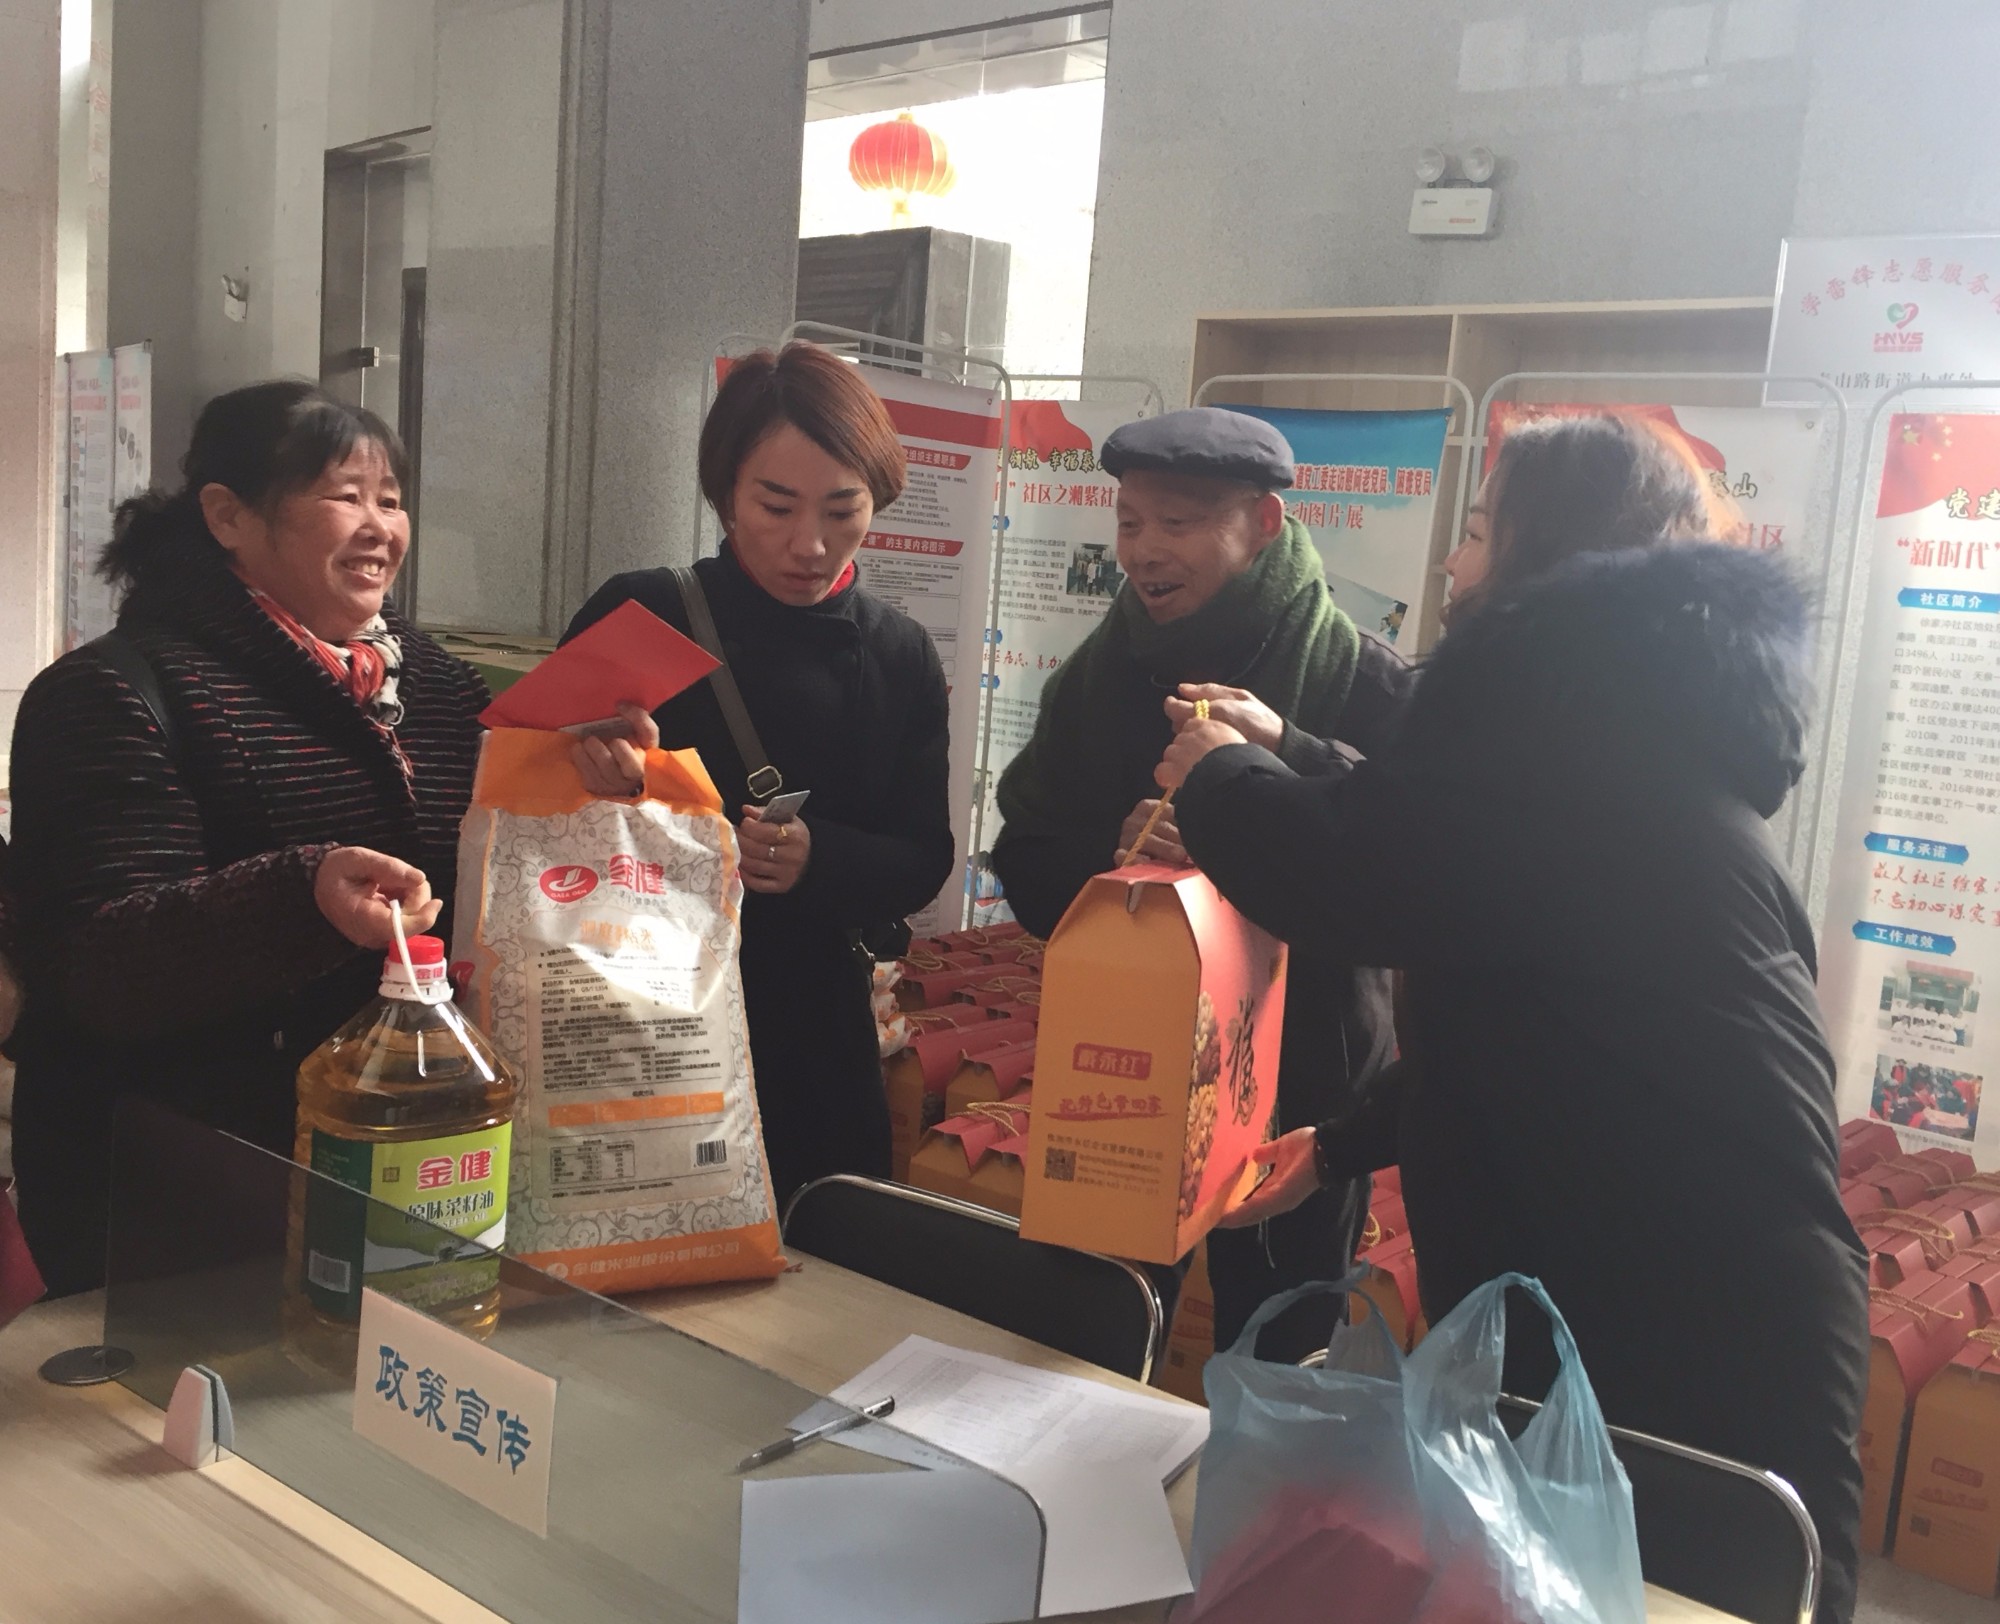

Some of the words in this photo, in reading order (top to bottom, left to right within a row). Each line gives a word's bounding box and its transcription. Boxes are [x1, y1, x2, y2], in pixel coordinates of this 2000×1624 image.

[1873, 332, 1924, 346] HNVS
[1290, 464, 1433, 496] 道党工委走访慰问老党员、困难党员
[1284, 501, 1364, 529] 动图片展
[1920, 593, 1982, 608] 社区简介
[1886, 838, 1948, 859] 服务承诺
[609, 854, 667, 895] 金健
[1873, 927, 1935, 949] 工作成效
[417, 1150, 492, 1191] 金健
[404, 1190, 494, 1224] 原味菜籽油
[572, 1242, 740, 1276] 金健米业股份有限公司
[375, 1345, 532, 1475] 政策宣传
